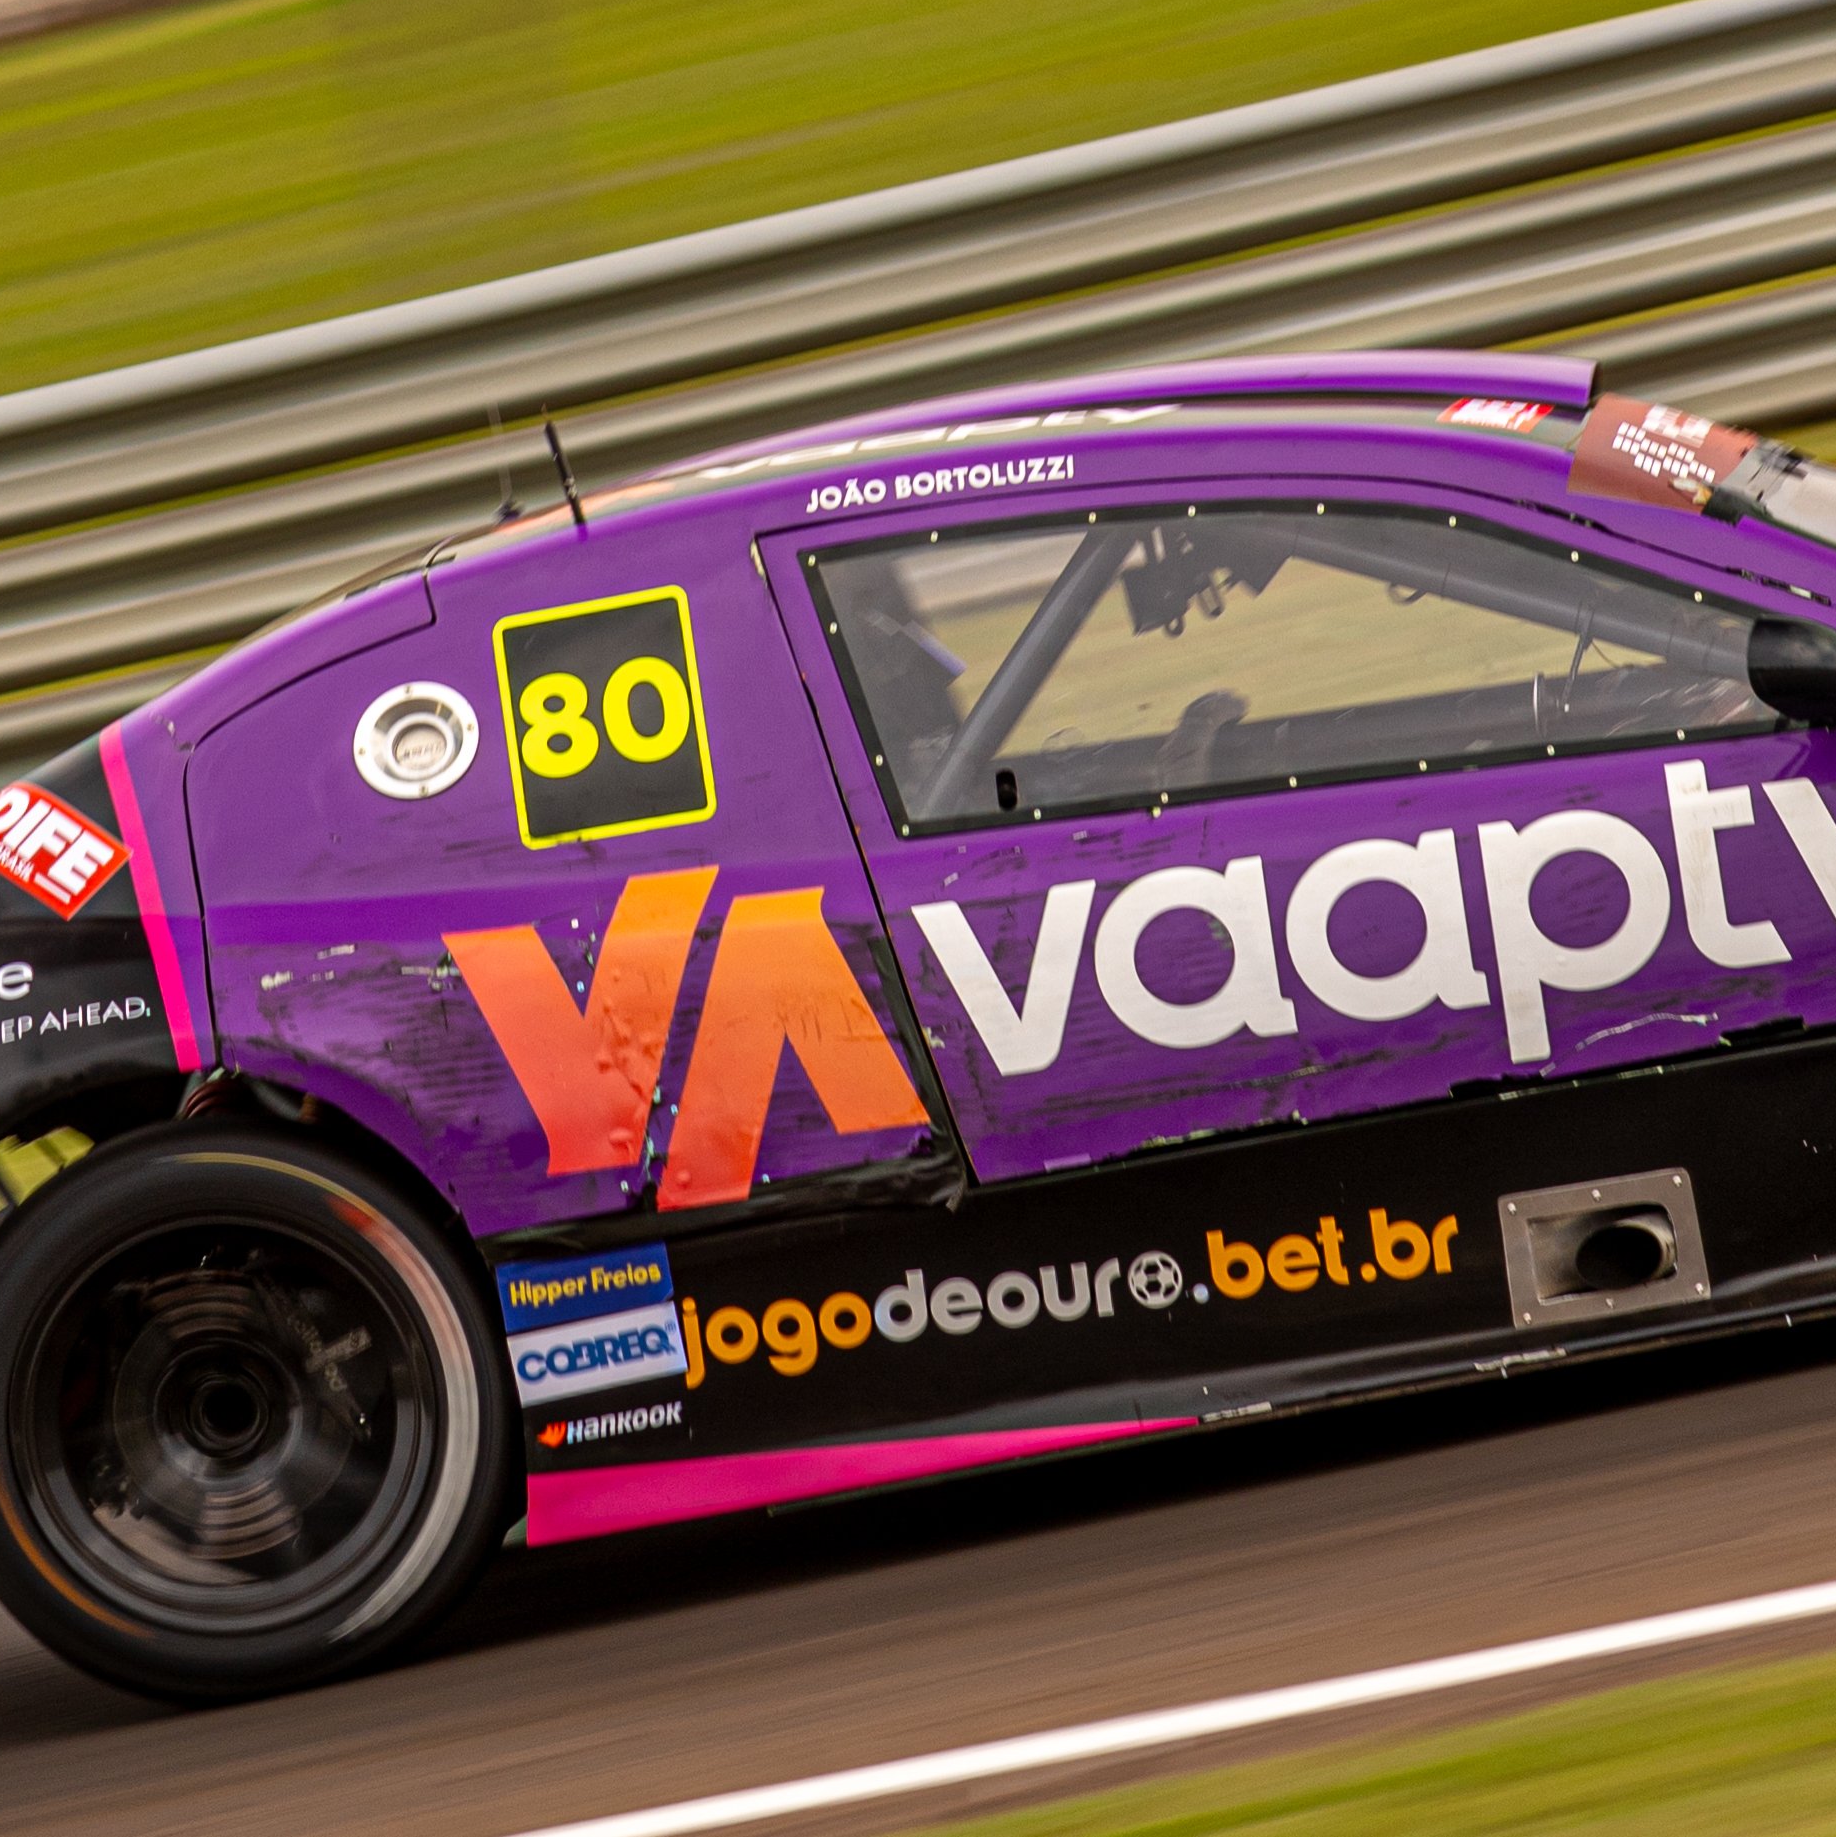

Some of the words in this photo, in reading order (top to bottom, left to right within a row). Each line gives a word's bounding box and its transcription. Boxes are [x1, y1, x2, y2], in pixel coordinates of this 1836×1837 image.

[805, 477, 887, 514] JOÃO
[894, 454, 1075, 501] BORTOLUZZI
[518, 655, 691, 779] 80
[39, 995, 152, 1036] AHEAD.
[509, 1274, 588, 1309] Hipper
[590, 1262, 662, 1294] Freios
